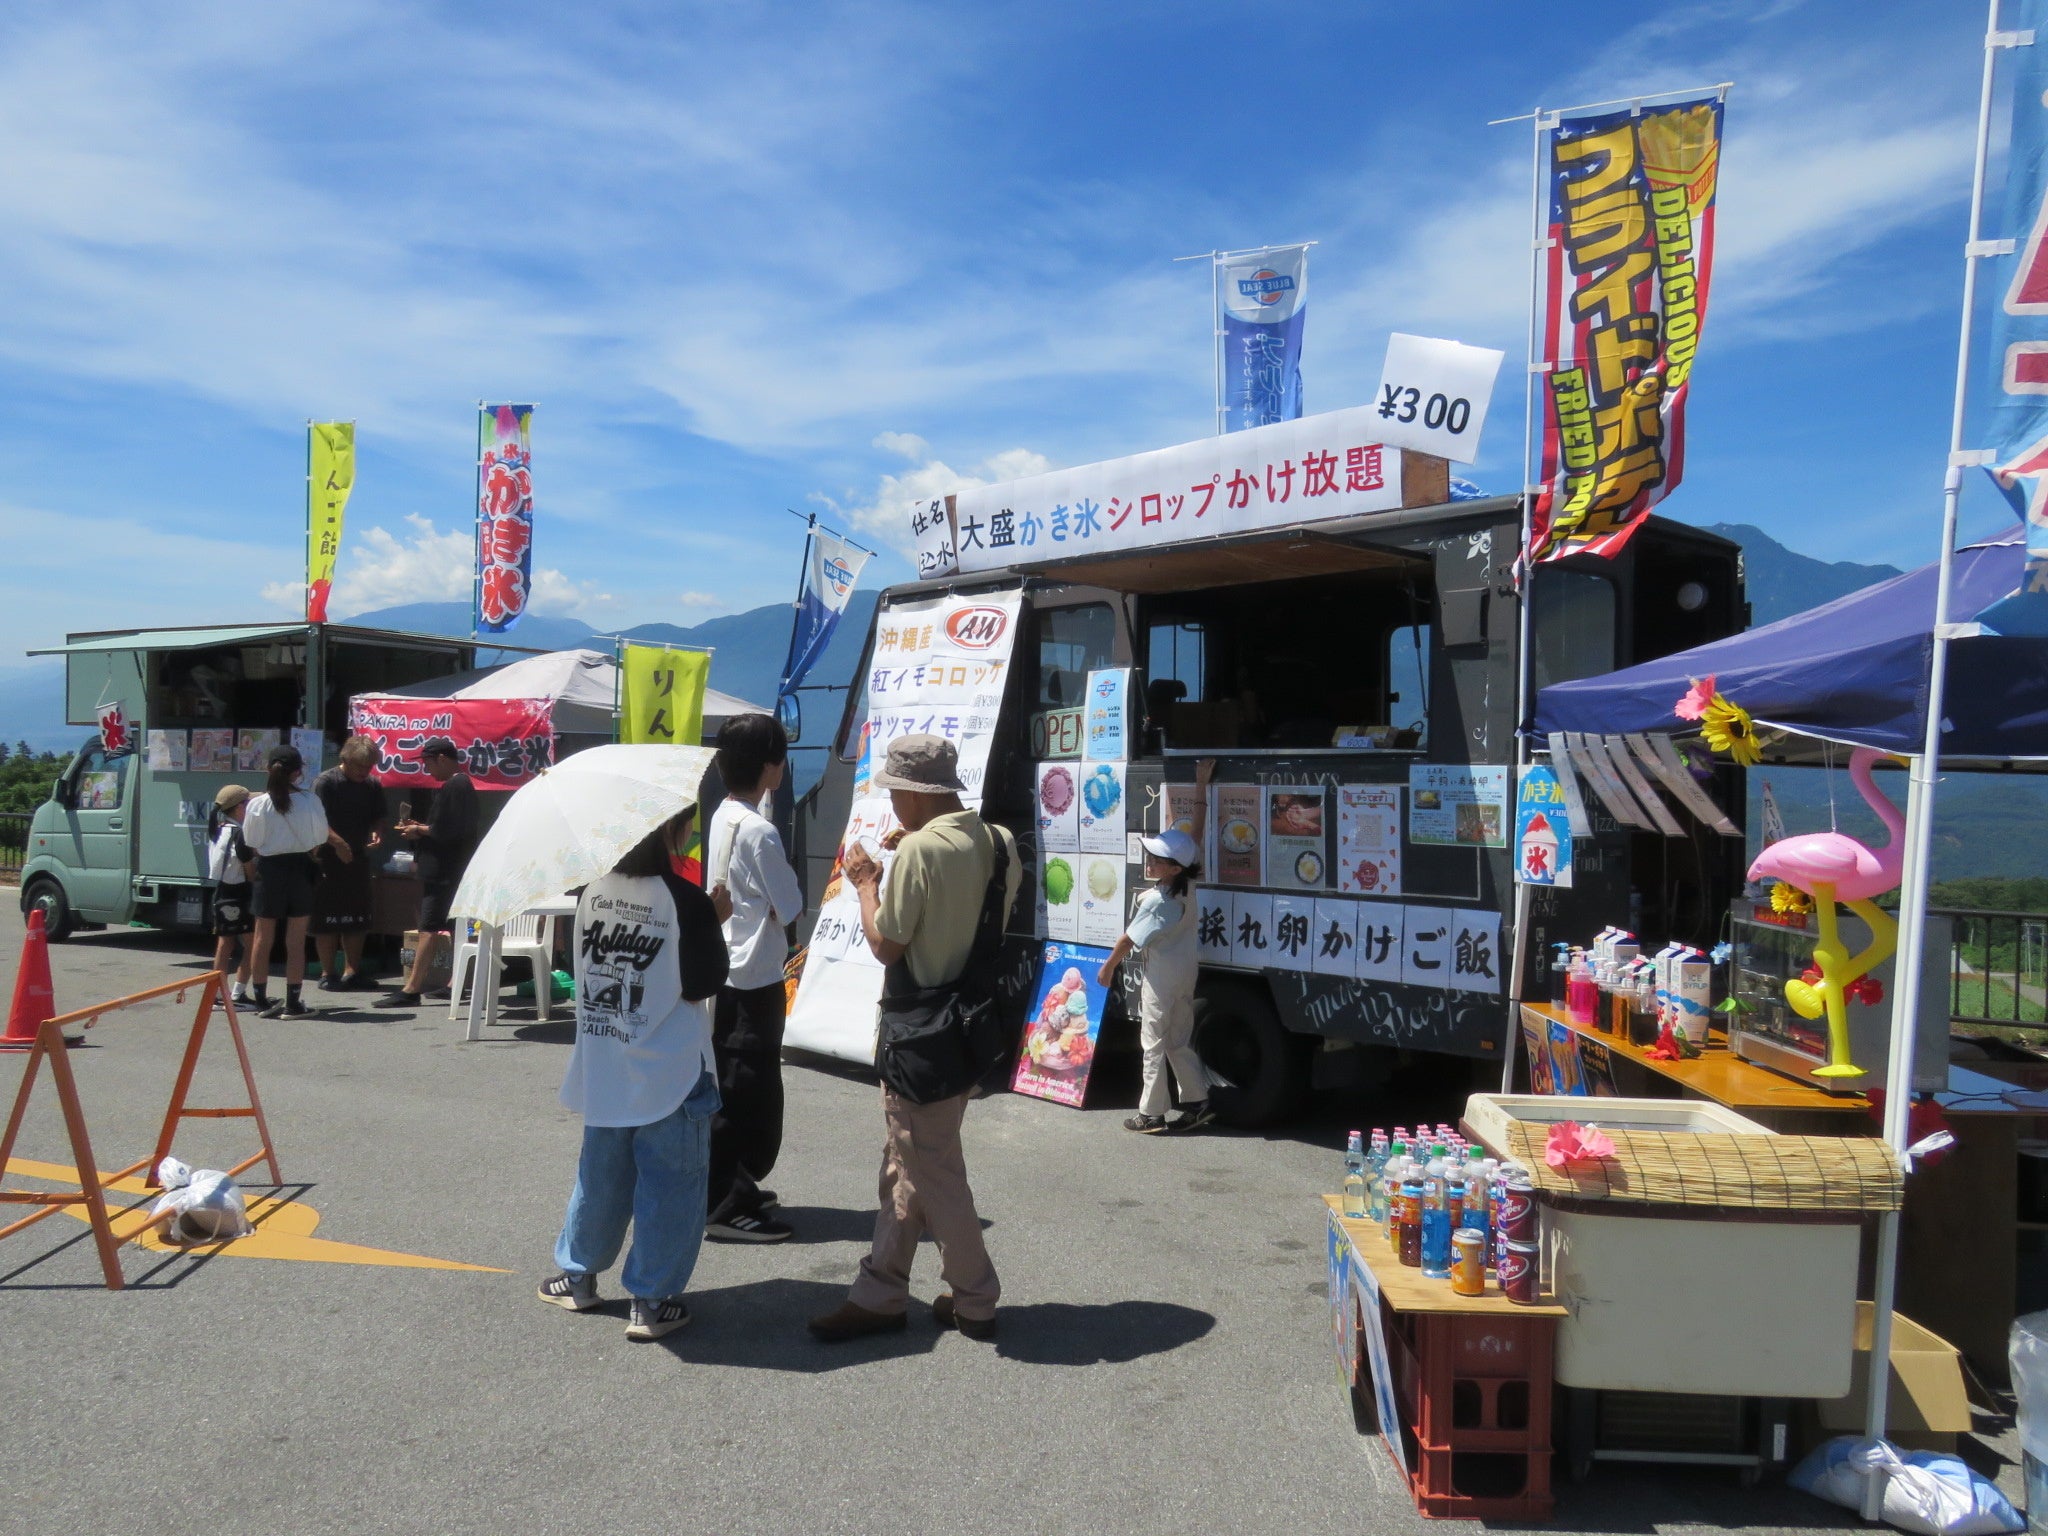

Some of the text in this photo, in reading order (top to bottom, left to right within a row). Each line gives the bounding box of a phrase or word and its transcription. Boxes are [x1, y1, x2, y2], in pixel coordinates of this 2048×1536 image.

[1651, 186, 1700, 388] DELICIOUS
[1378, 384, 1470, 434] ¥300
[1551, 367, 1597, 470] FRIED
[959, 443, 1386, 553] 大盛かき氷シロップかけ放題
[484, 467, 533, 621] かき氷
[878, 623, 934, 652] 沖縄産
[871, 660, 1004, 693] 紅イモコロッケ
[360, 714, 452, 729] PAKIRA no MI
[648, 669, 676, 738] りん
[102, 710, 130, 750] 氷
[871, 715, 960, 739] サツマイモ
[850, 813, 903, 836] カーリ
[1526, 846, 1548, 876] 氷
[616, 899, 629, 909] the
[630, 903, 654, 914] waves
[1198, 906, 1496, 979] 採れ卵かけご飯
